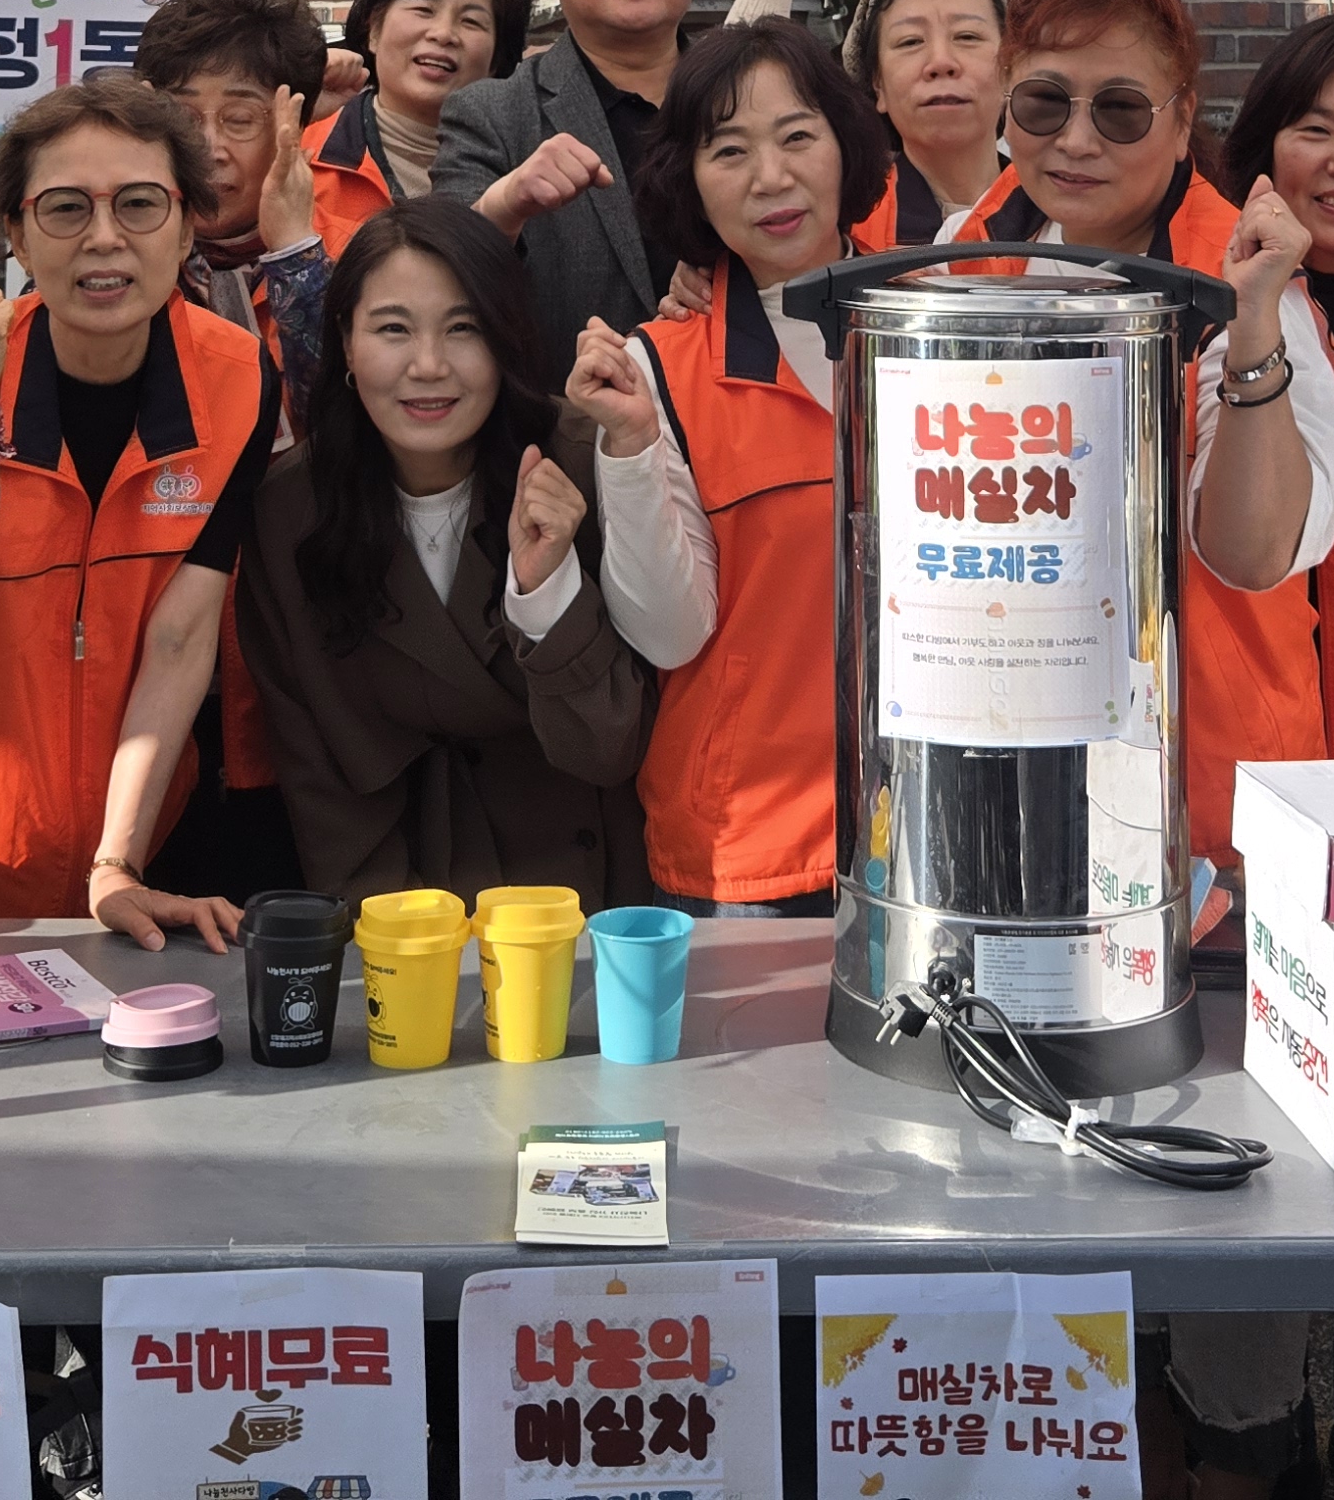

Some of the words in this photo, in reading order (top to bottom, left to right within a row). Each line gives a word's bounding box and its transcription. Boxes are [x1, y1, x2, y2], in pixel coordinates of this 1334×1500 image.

[913, 401, 1074, 460] 나눔의
[914, 465, 1077, 524] 매실차
[915, 541, 1064, 585] 무료제공
[1280, 945, 1329, 1027] 마음으로
[130, 1325, 394, 1394] 식혜무료
[513, 1315, 712, 1389] 나눔의
[898, 1362, 1058, 1406] 매실차로
[513, 1393, 717, 1468] 매실차
[830, 1412, 989, 1458] 따뜻함을
[1005, 1416, 1128, 1462] 나눠요
[203, 1485, 257, 1499] 나눔천사다방
